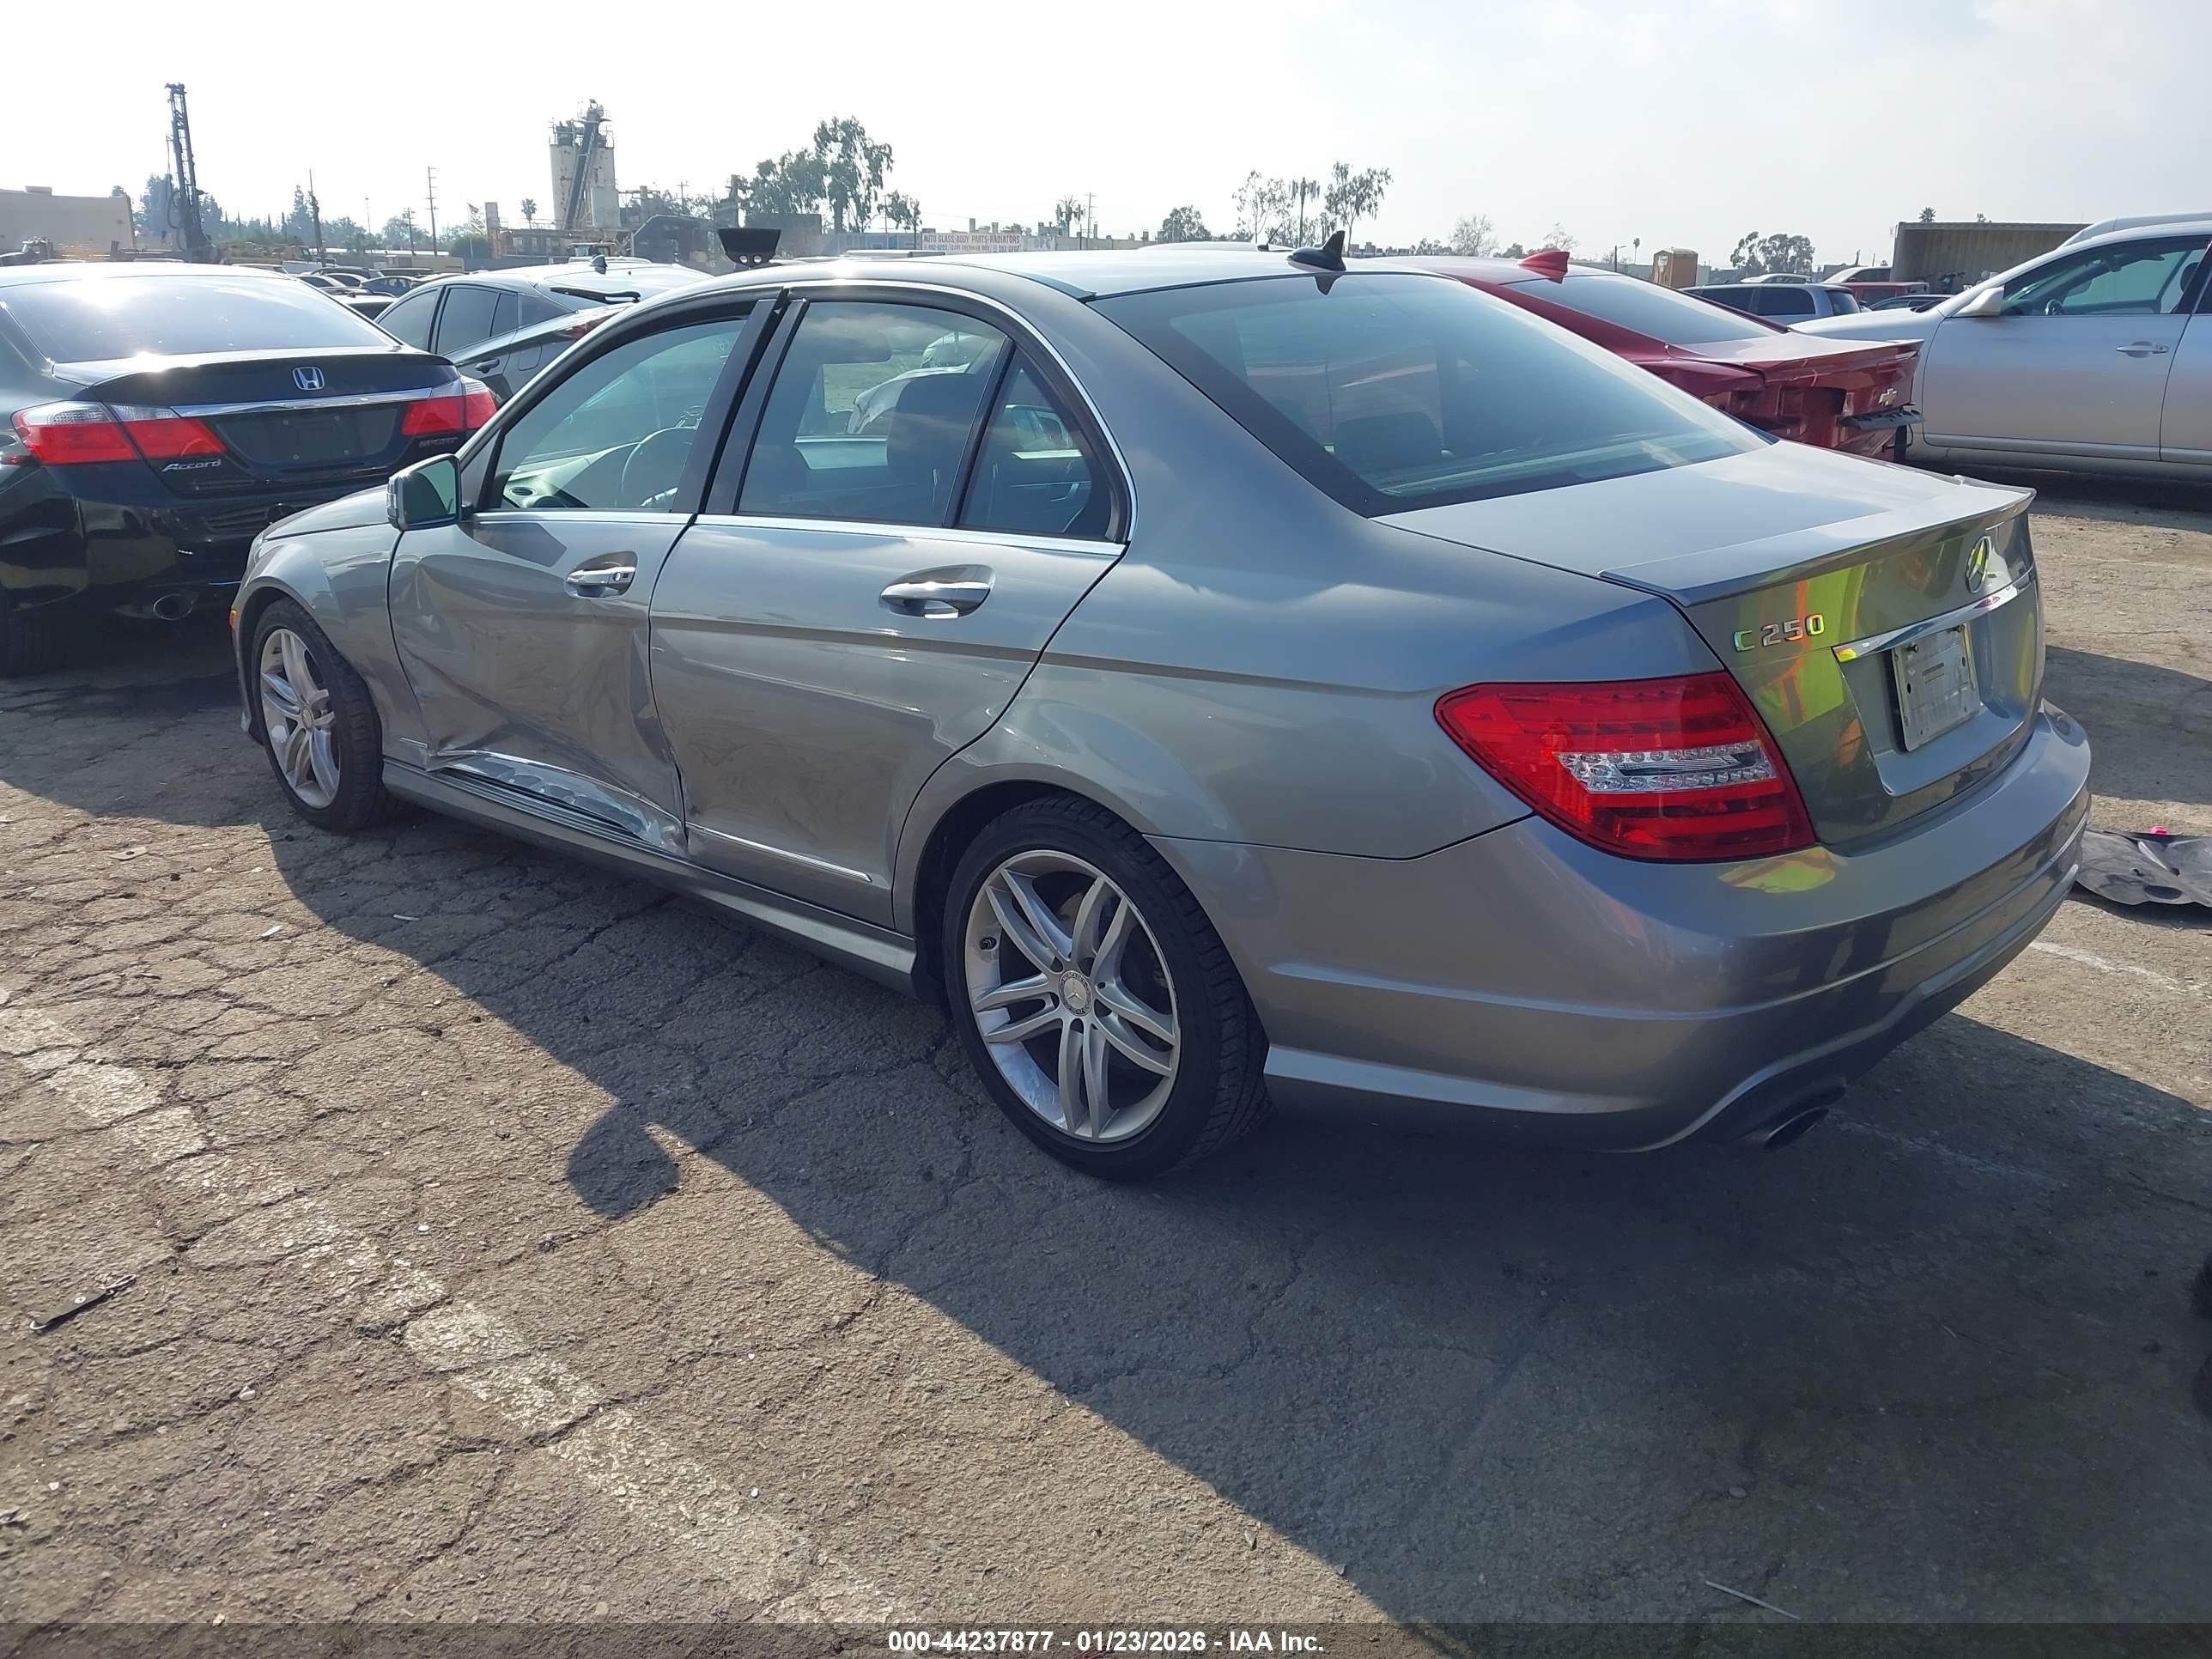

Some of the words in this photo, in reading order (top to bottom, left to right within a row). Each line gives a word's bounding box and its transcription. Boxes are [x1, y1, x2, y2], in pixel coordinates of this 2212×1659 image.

[161, 459, 222, 472] Accord
[1733, 629, 1755, 652] C
[1760, 614, 1824, 647] 250
